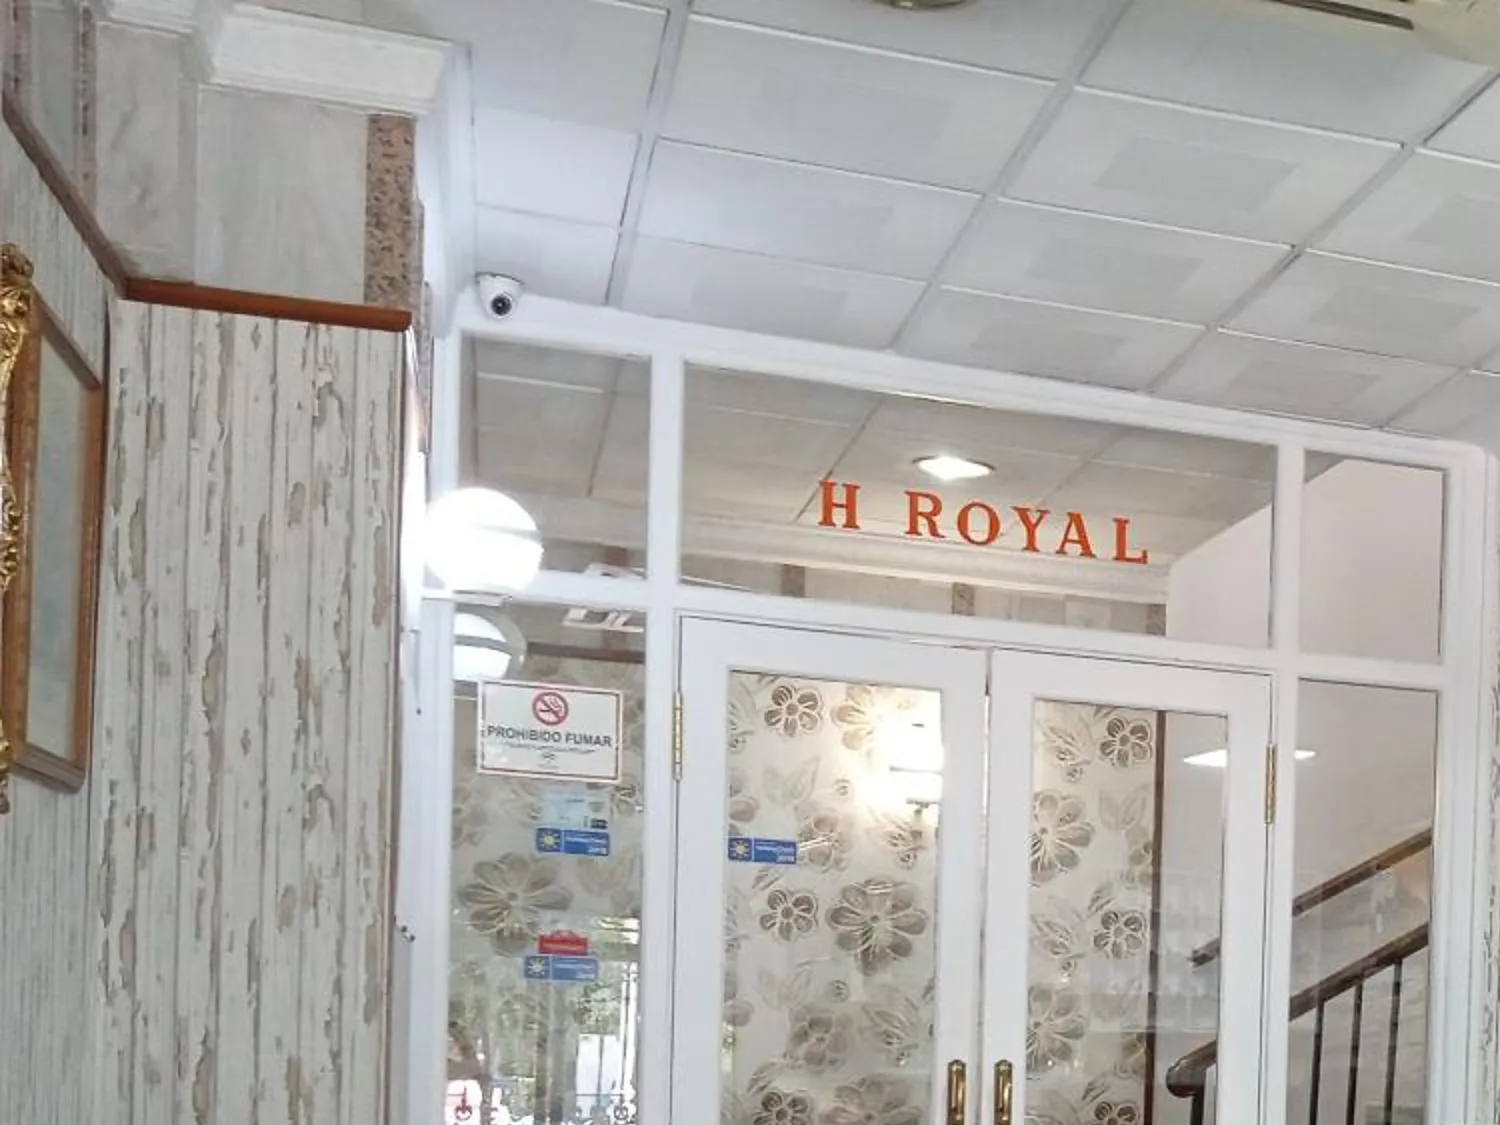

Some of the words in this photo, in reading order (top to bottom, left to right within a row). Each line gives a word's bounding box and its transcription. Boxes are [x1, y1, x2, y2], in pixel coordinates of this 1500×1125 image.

[818, 479, 861, 529] H
[904, 490, 1149, 565] ROYAL
[487, 725, 562, 743] PROHIBIDO
[565, 731, 613, 747] FUMAR
